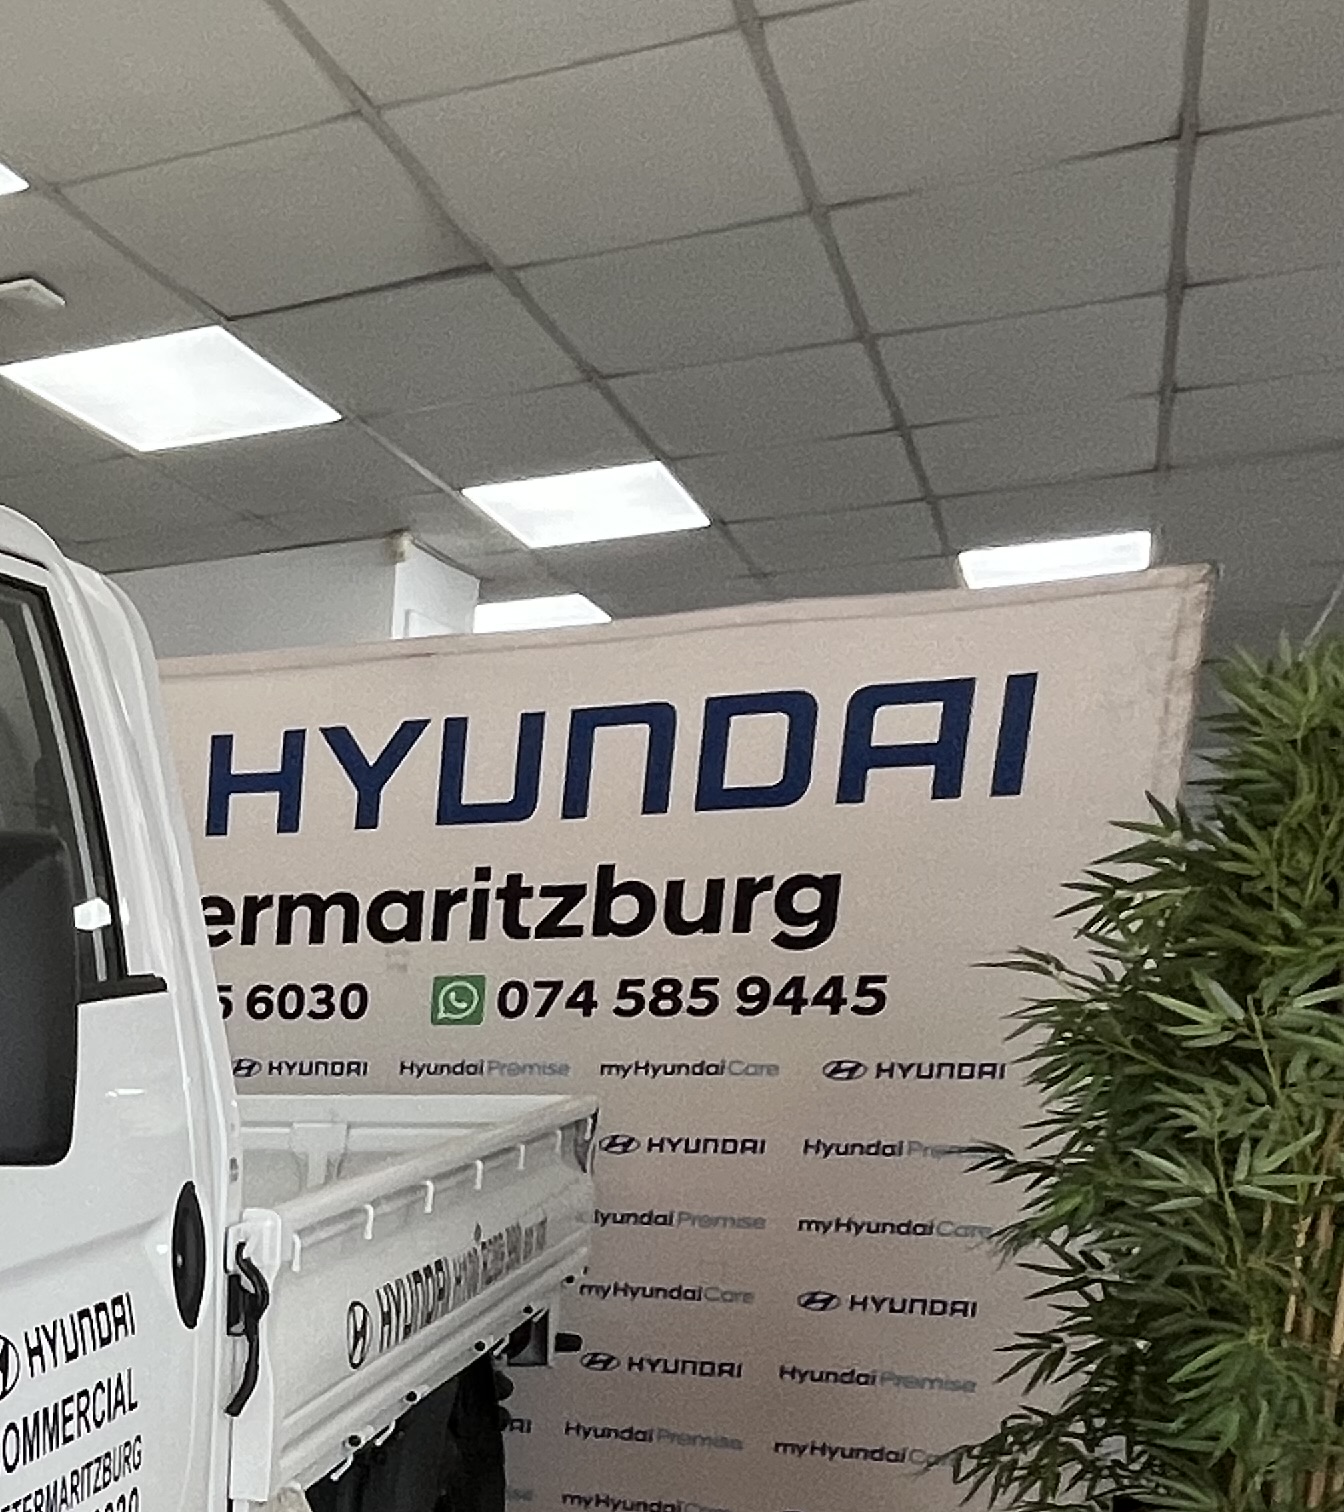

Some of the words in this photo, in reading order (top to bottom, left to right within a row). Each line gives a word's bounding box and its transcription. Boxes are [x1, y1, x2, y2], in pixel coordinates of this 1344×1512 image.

[205, 673, 1039, 837] HYUNDAI
[202, 864, 841, 950] ermaritzburg
[246, 982, 369, 1020] 6030
[497, 979, 598, 1019] 074
[613, 976, 720, 1018] 585
[736, 974, 888, 1017] 9445
[268, 1060, 368, 1076] HYUNDAI
[875, 1062, 1006, 1080] HYUNDAI
[646, 1138, 766, 1155] HYUNDAI
[849, 1294, 977, 1318] HYUNDAI
[23, 1292, 136, 1378] HYUNDAI
[627, 1355, 743, 1379] HYUNDAI
